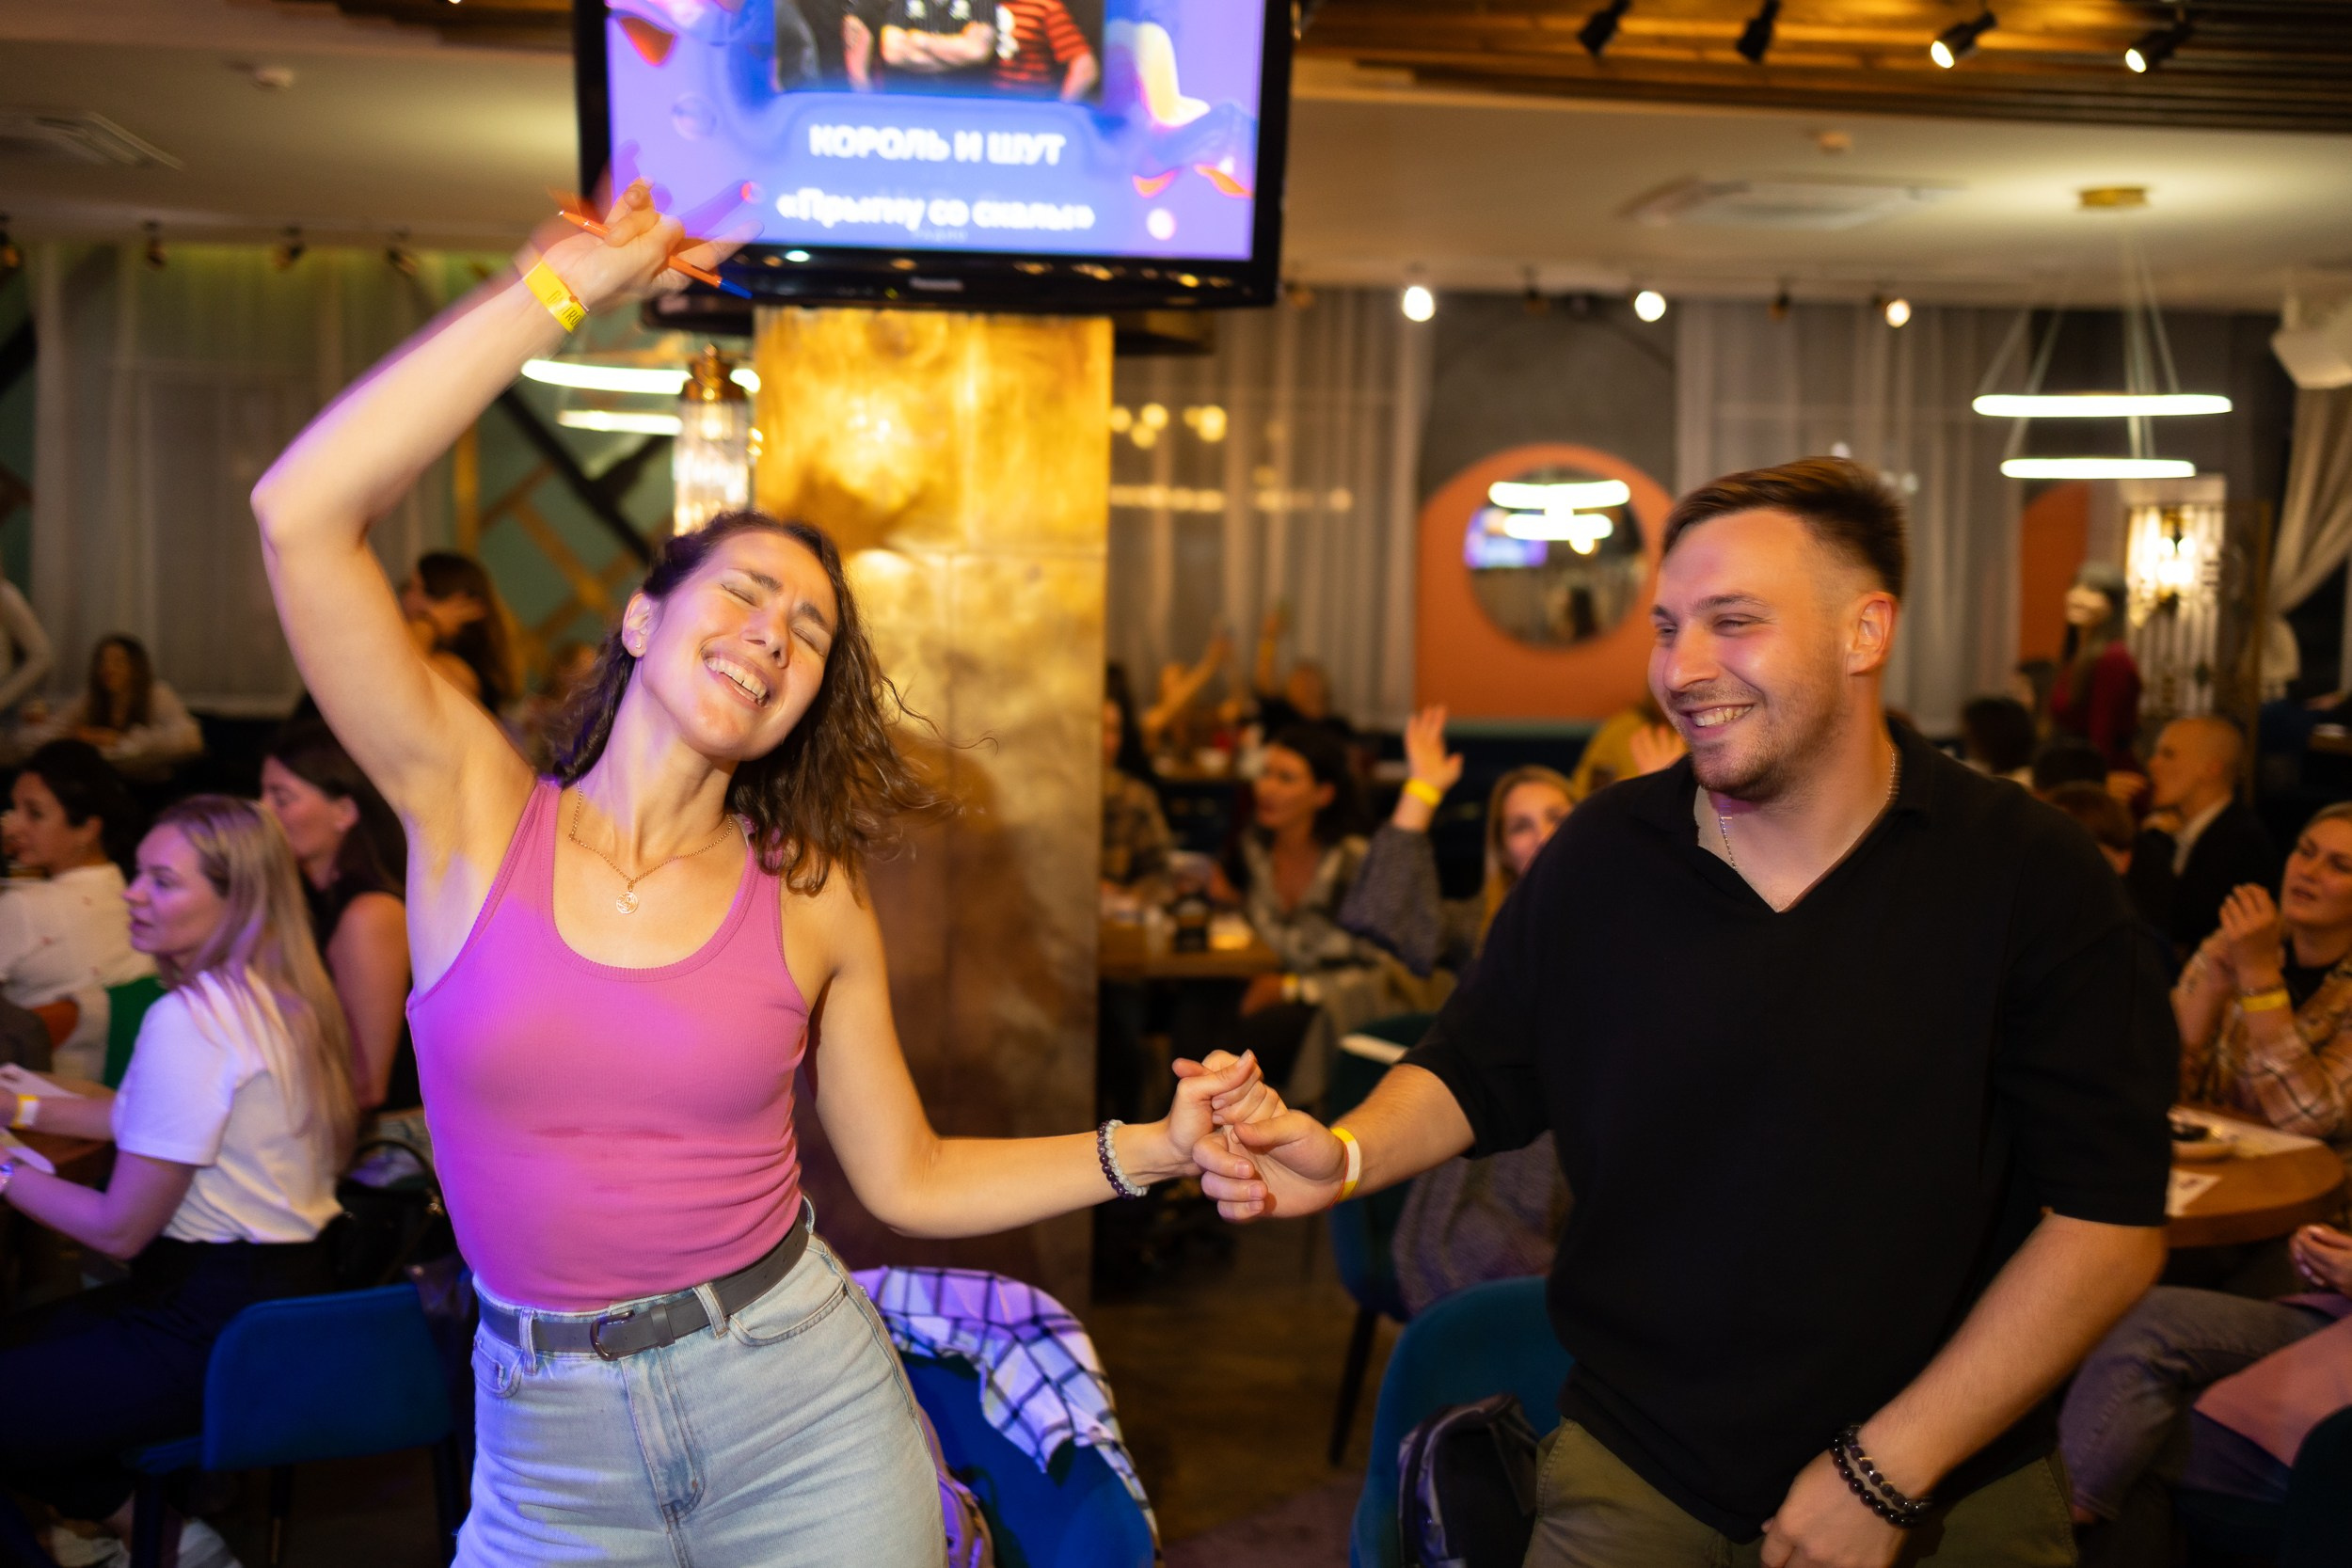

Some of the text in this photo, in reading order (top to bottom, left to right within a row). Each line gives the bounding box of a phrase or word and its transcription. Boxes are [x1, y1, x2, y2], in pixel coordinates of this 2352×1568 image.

[809, 125, 1066, 165] КОРОЛЬ И ШУТ
